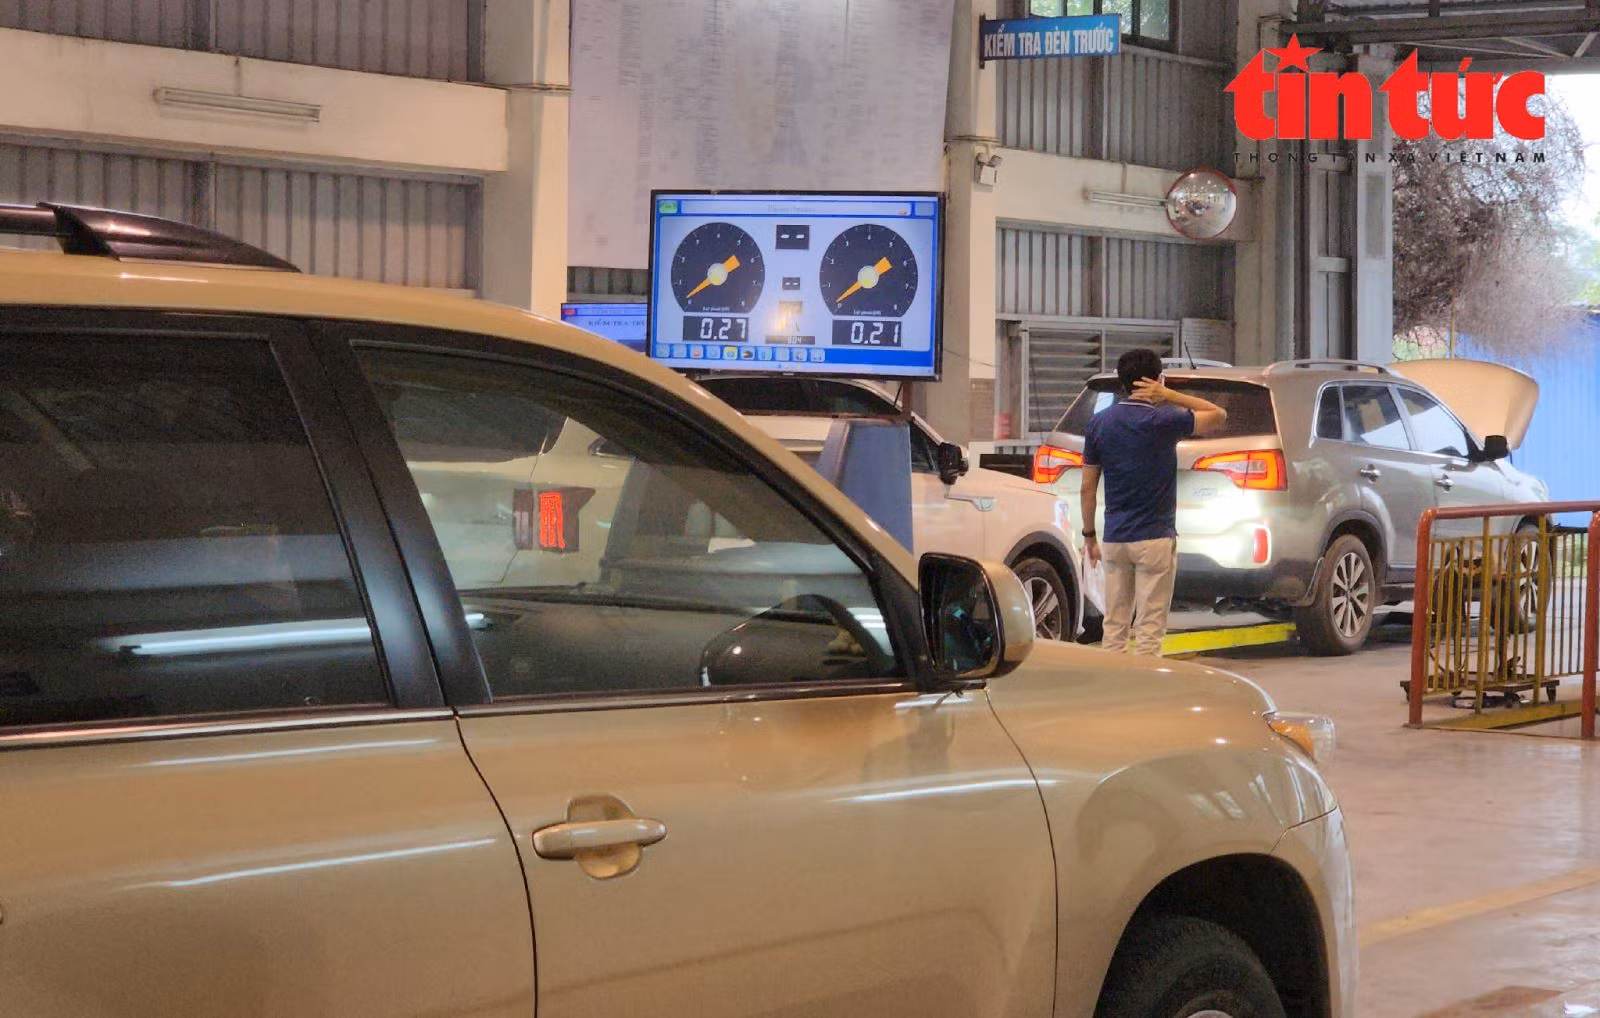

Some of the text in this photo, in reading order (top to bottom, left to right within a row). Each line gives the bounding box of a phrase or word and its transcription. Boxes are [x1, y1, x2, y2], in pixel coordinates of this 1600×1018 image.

[983, 21, 1114, 57] KIỂM TRA ĐÈN TRƯỚC
[700, 317, 747, 340] 0.27
[850, 321, 900, 345] 0.21
